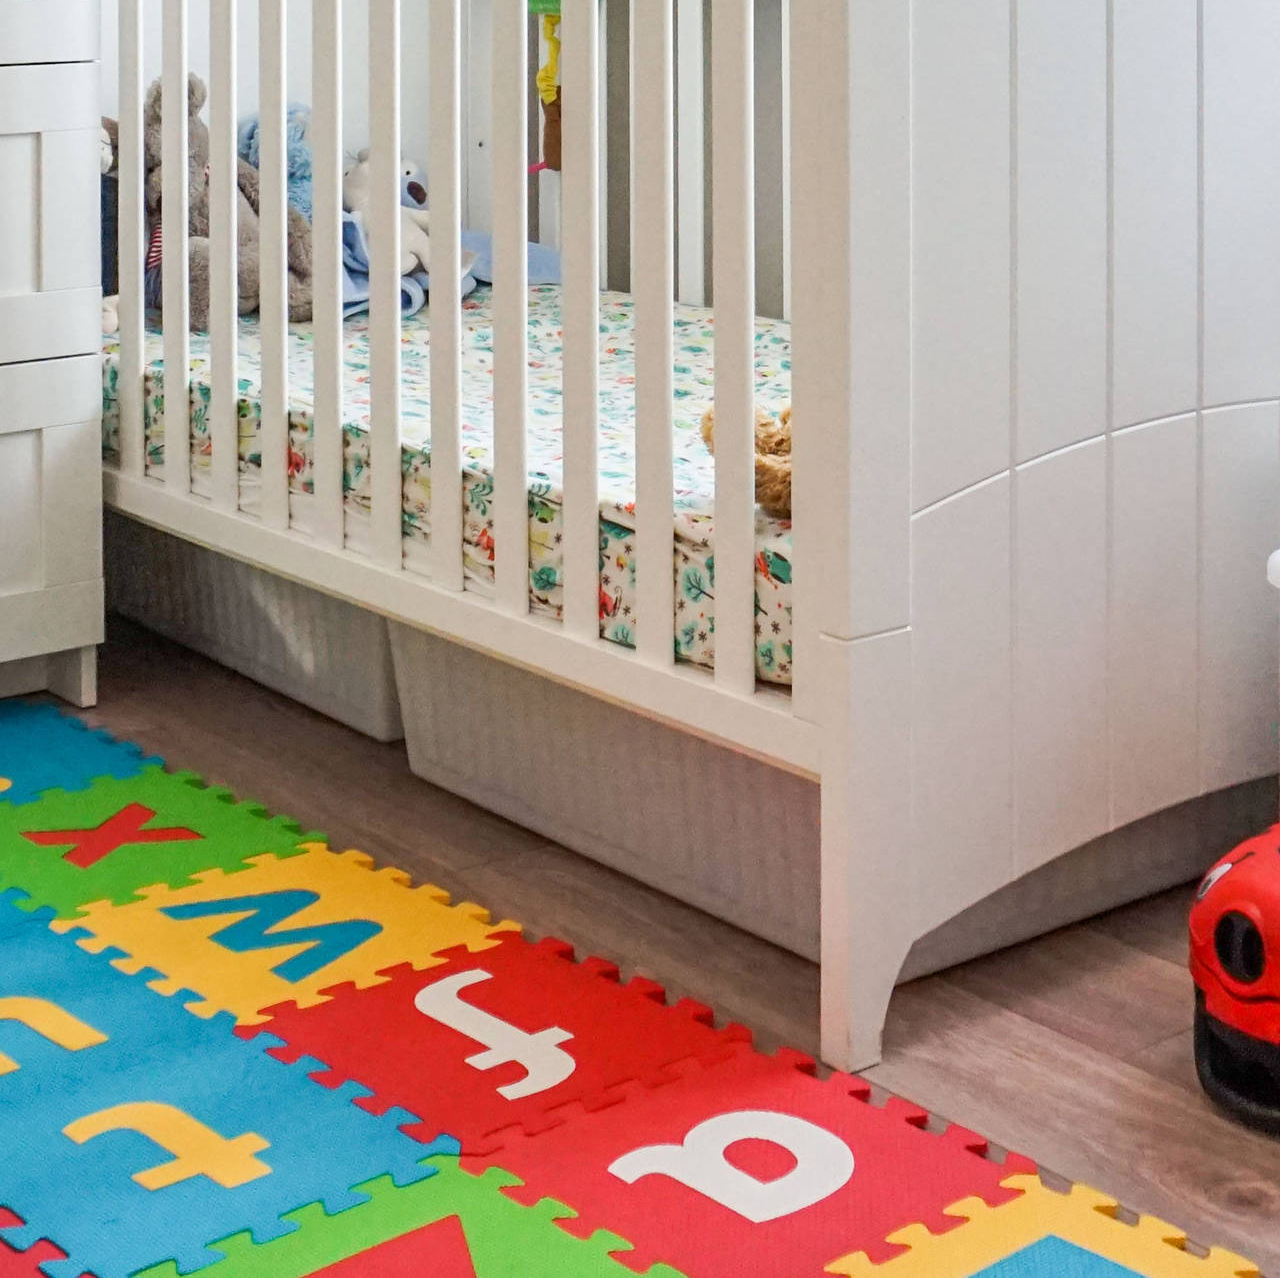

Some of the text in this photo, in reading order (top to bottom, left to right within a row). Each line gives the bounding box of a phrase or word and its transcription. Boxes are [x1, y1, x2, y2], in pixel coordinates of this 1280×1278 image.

[21, 802, 202, 869] x
[414, 968, 576, 1101] f
[62, 1101, 271, 1190] t
[607, 1110, 855, 1223] a
